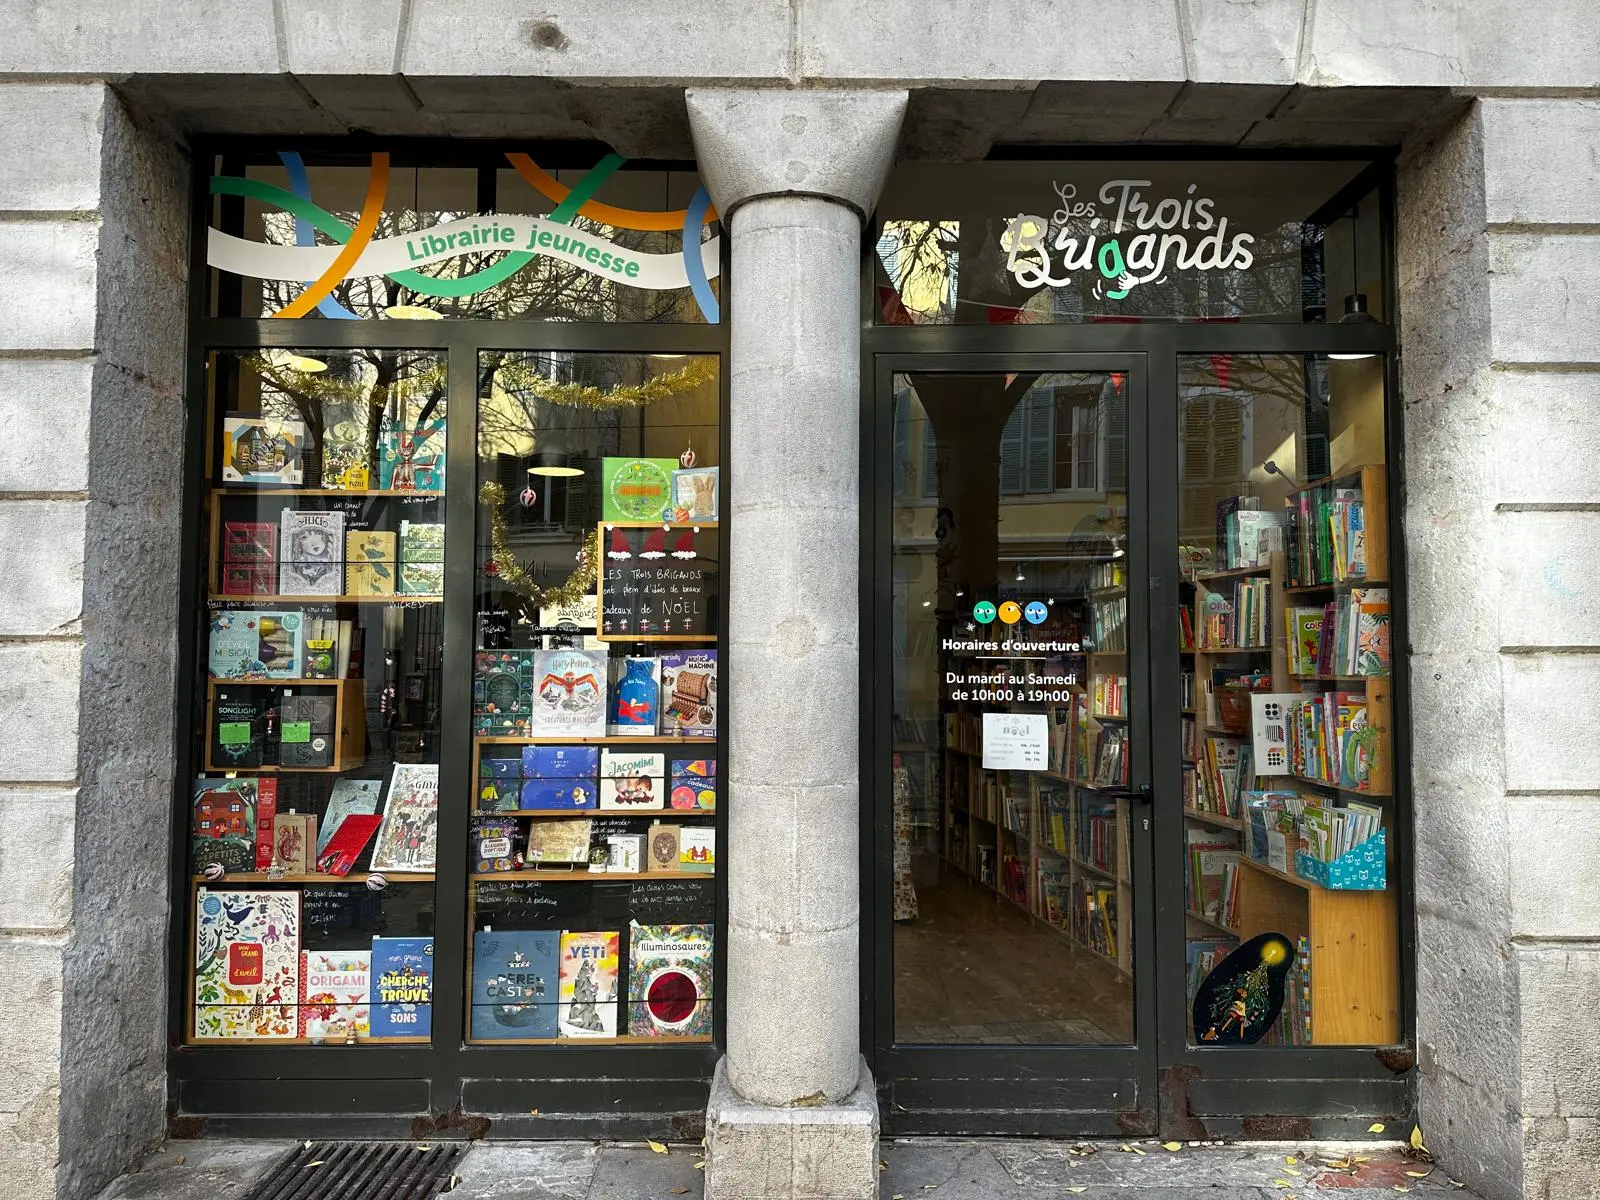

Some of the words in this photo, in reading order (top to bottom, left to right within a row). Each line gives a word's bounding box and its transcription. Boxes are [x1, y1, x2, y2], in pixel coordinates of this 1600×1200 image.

[1053, 180, 1096, 225] Les
[1099, 180, 1214, 234] Trois
[406, 222, 515, 262] Librairie
[527, 223, 640, 277] jeunesse
[1006, 213, 1255, 300] Brigands
[656, 568, 701, 580] BRIGANDS
[670, 584, 679, 594] de
[682, 584, 701, 593] beaux
[640, 603, 653, 614] de
[942, 638, 998, 651] Horaires
[1001, 638, 1080, 652] d'ouverture
[946, 673, 965, 684] Du
[968, 672, 1005, 685] mardi
[1008, 675, 1024, 685] au
[1028, 673, 1076, 686] Samedi
[952, 689, 968, 701] de
[972, 689, 1013, 701] 10h00
[1017, 689, 1024, 701] à
[1028, 690, 1069, 702] 19h00
[687, 780, 714, 790] cadeaux
[641, 942, 707, 952] Illuminosaures
[403, 954, 422, 964] grand
[310, 975, 366, 987] ORIGAMI
[380, 975, 429, 986] CHERCHE
[380, 989, 429, 1002] TROUVE
[486, 986, 545, 997] CASTOR
[390, 1013, 418, 1023] SONS
